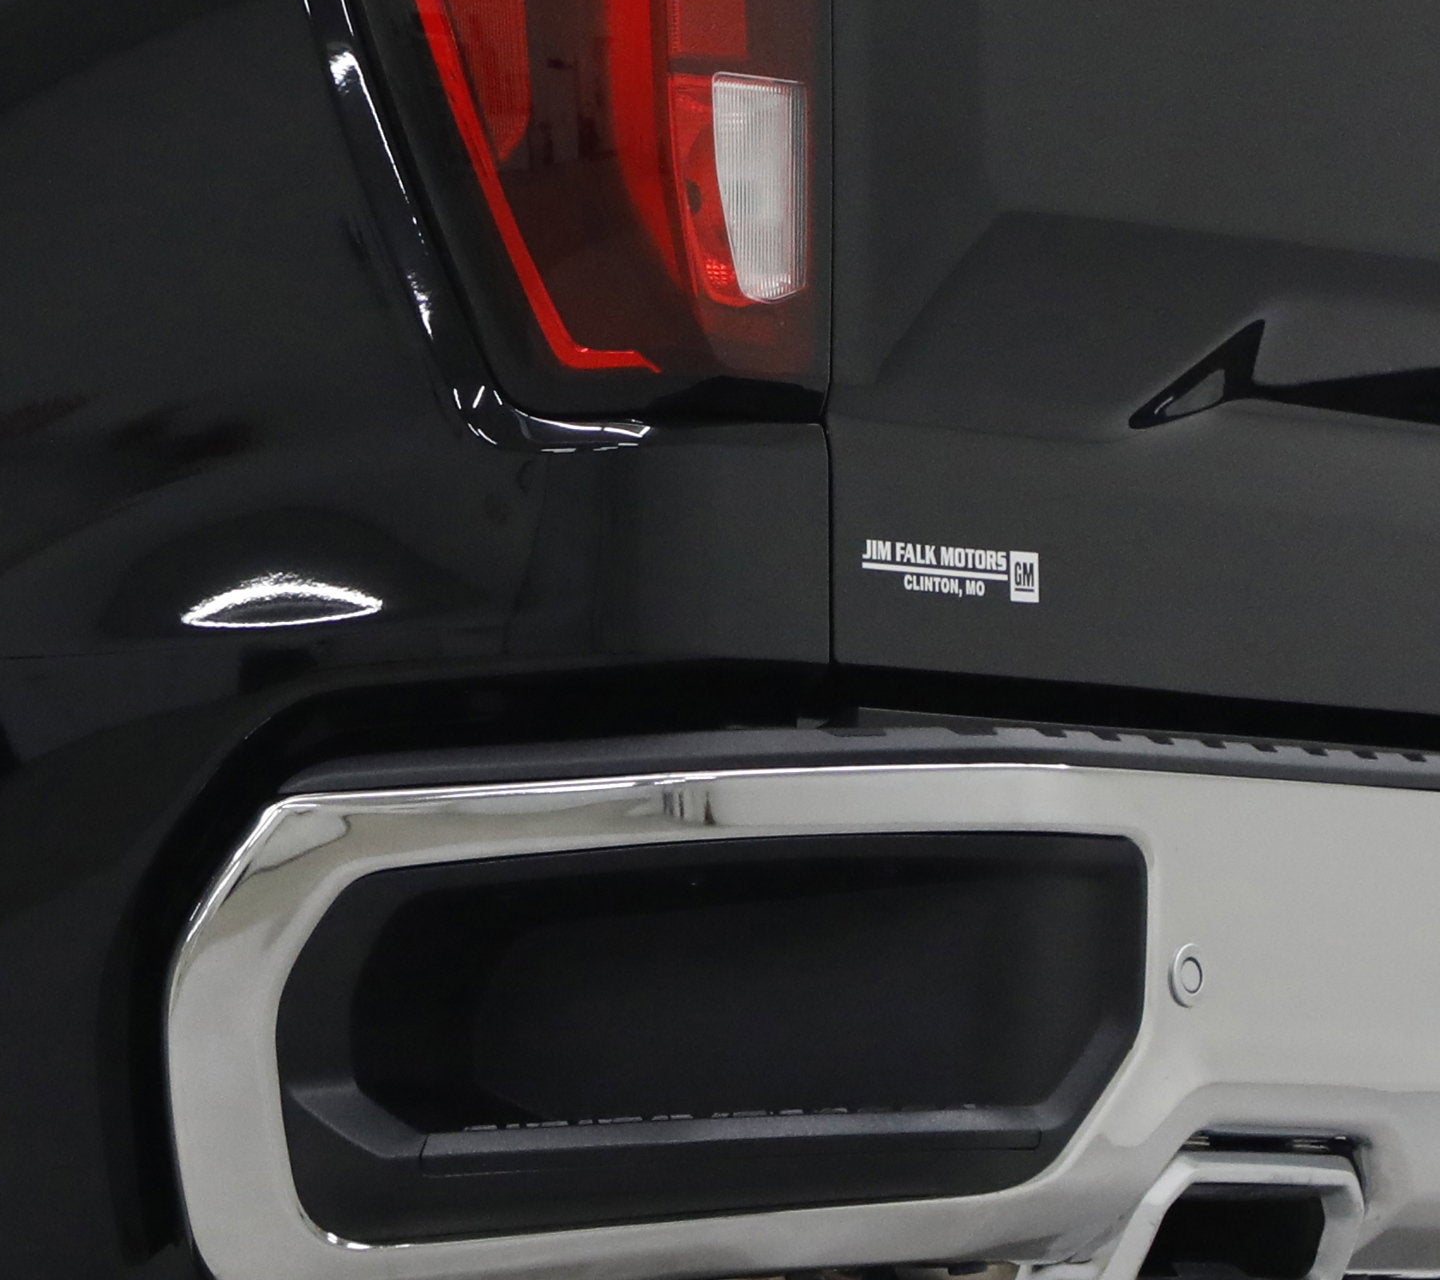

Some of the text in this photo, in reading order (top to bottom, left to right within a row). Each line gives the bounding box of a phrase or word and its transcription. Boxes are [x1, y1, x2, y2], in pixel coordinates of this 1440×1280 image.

[862, 539, 1008, 571] JIM FALK MOTORS
[903, 574, 986, 598] CLINTON, MO
[1014, 561, 1035, 588] GM
